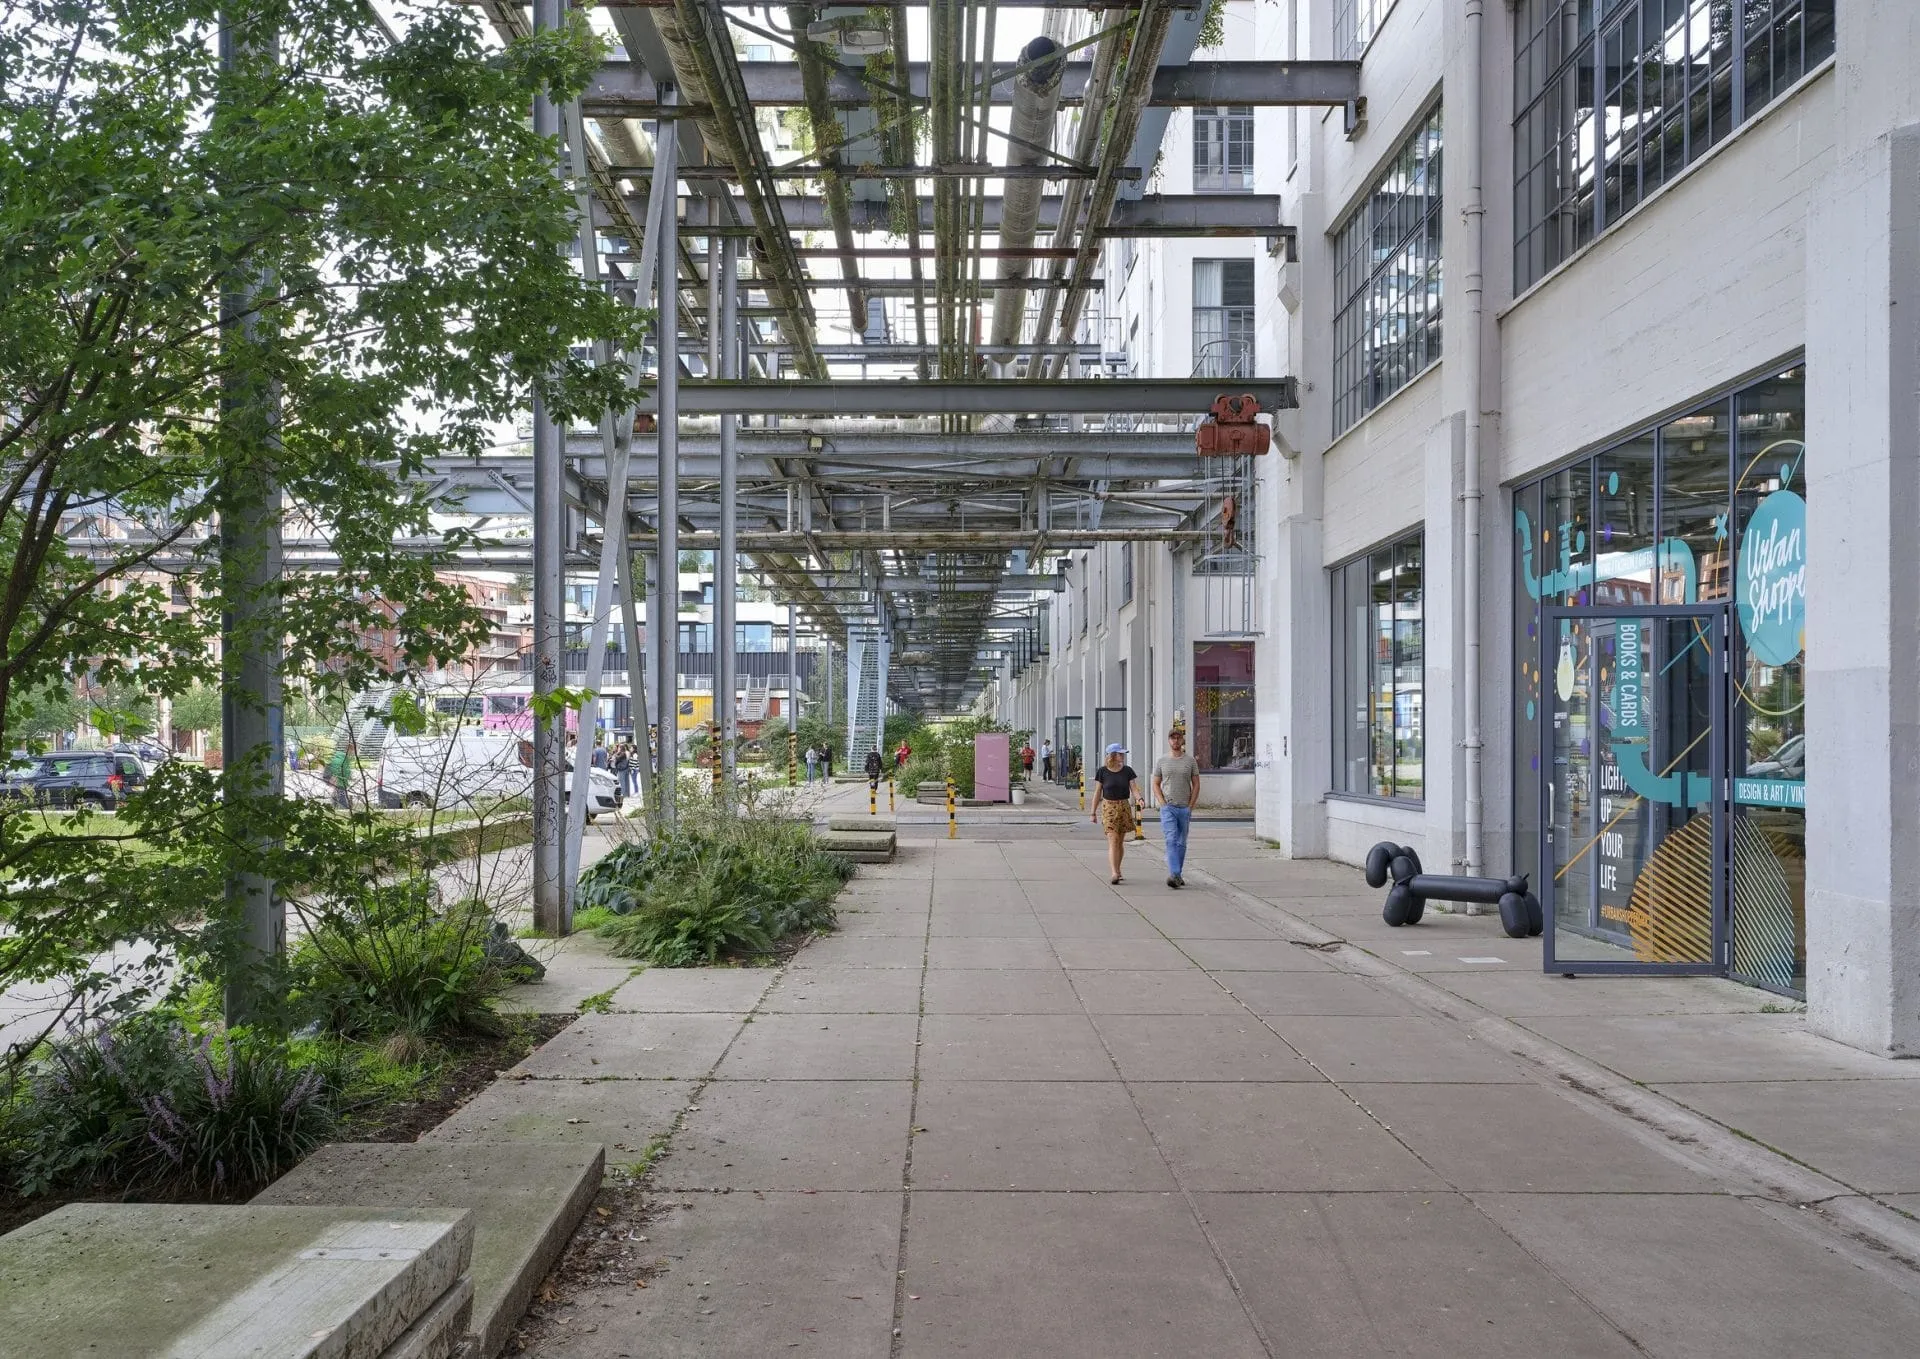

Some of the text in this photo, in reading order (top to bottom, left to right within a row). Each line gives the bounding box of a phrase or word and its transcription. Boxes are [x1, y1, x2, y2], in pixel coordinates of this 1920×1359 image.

[1747, 518, 1801, 581] Urban
[1620, 624, 1638, 727] BOOKS & CARDS
[1739, 783, 1762, 801] DESIGN
[1763, 784, 1769, 800] &
[1770, 785, 1783, 802] ART
[1784, 785, 1790, 804] /
[1600, 798, 1612, 823] UP
[1601, 832, 1623, 859] YOUR
[1600, 864, 1617, 892] LIFE
